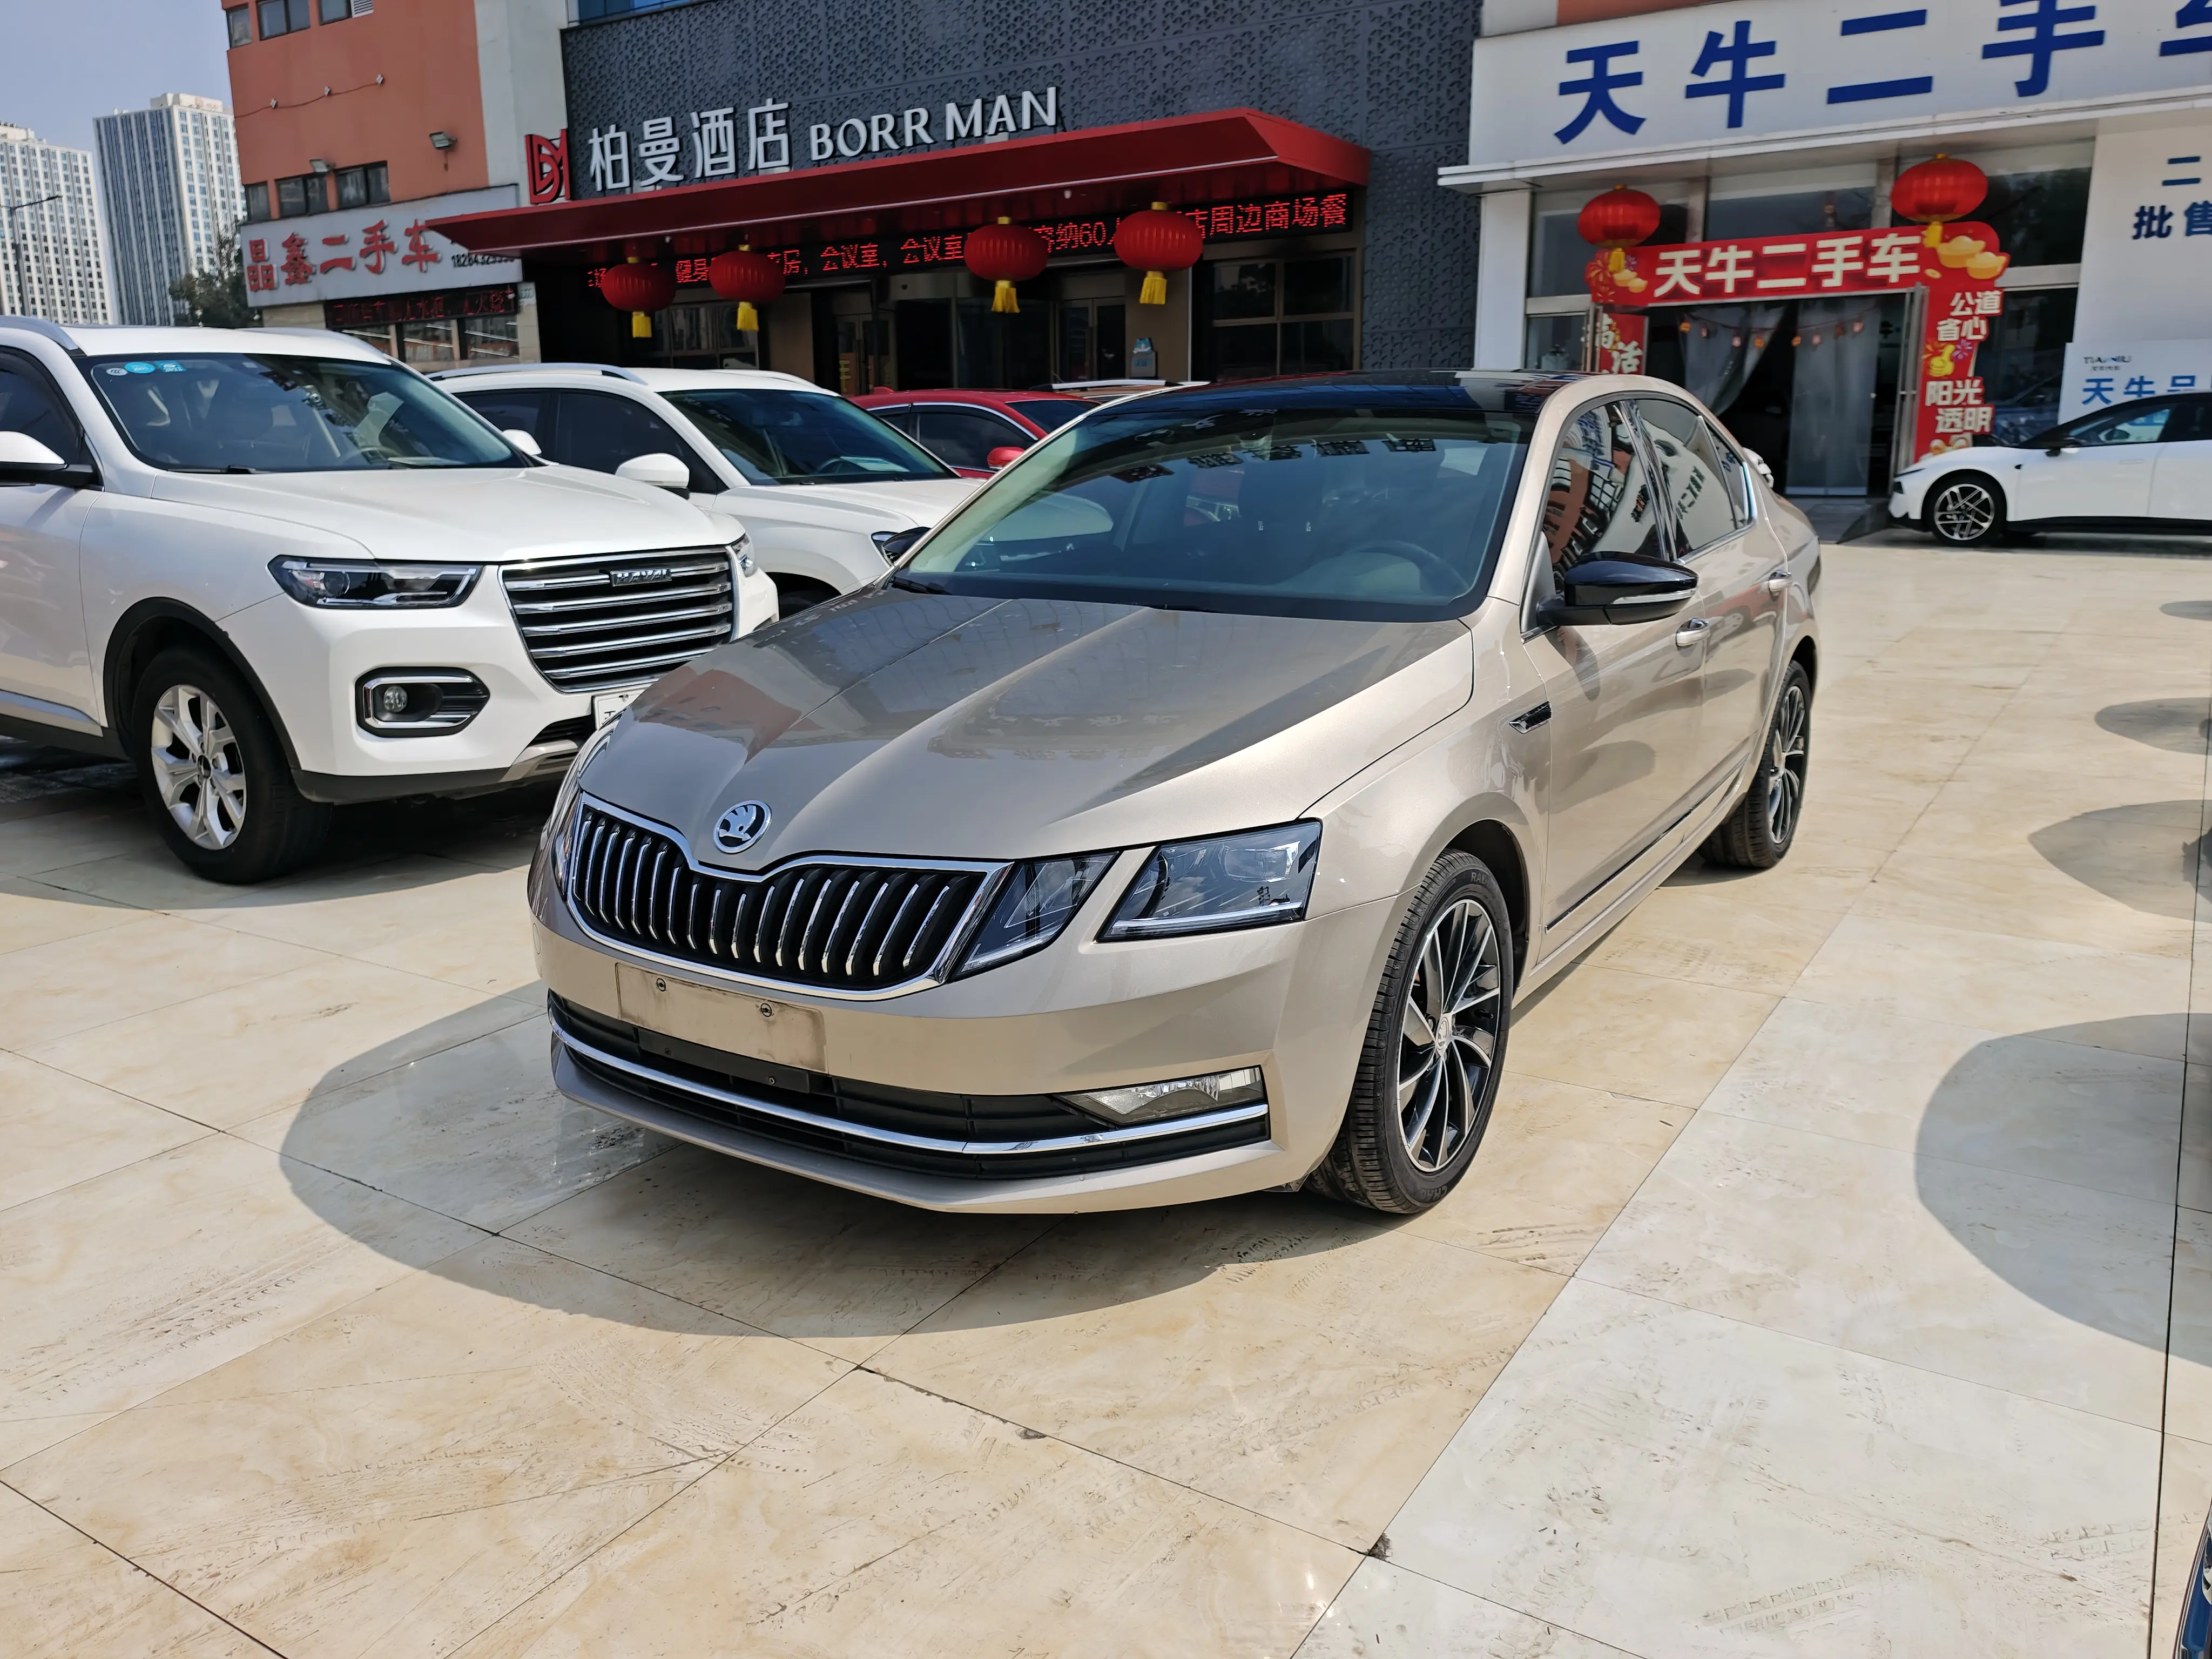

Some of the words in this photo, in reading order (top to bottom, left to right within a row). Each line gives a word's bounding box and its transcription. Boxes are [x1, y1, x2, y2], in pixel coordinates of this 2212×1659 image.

[588, 97, 791, 190] 柏曼酒店
[809, 107, 934, 161] BORR
[945, 86, 1057, 141] MAN
[247, 219, 443, 292] 晶鑫二手车
[1654, 233, 1921, 298] 天牛二手车
[1950, 290, 2001, 316] 公道
[1937, 316, 1987, 341] 省心
[1925, 379, 1982, 406] 阳光
[1935, 406, 1993, 434] 透明
